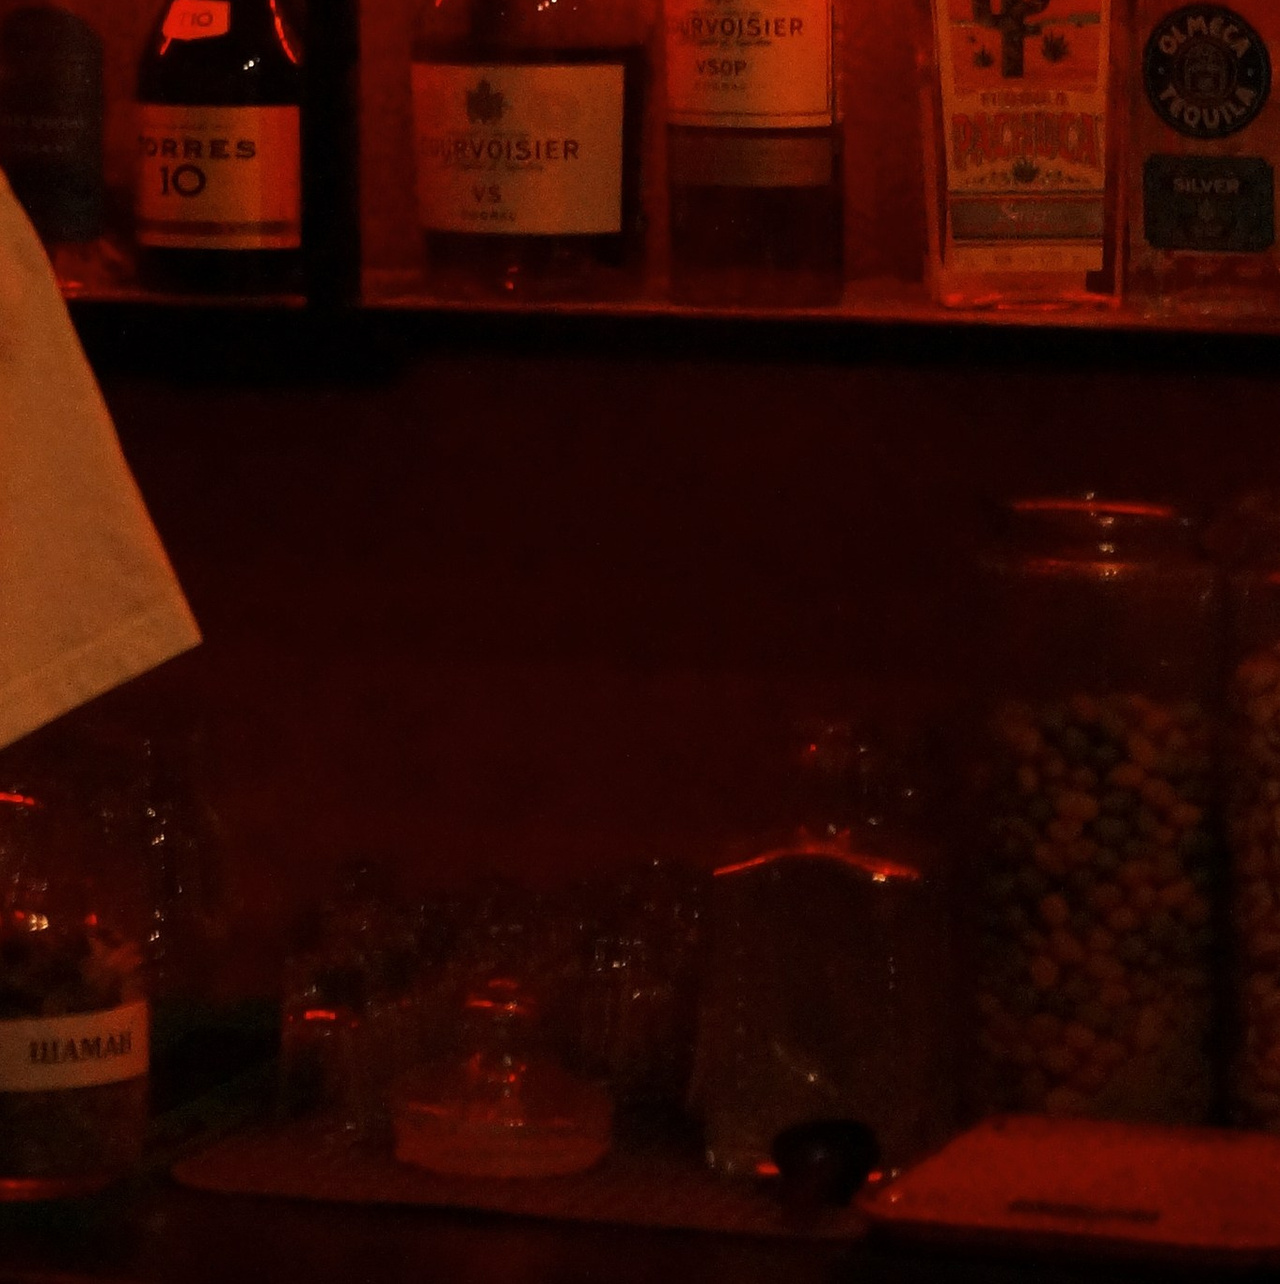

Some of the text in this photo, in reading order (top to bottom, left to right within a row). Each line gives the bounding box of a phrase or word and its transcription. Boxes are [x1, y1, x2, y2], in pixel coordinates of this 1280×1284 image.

[1158, 14, 1253, 59] OLMECA
[695, 59, 747, 76] VSOP
[1158, 82, 1258, 130] TEQUILA
[950, 110, 1099, 172] PACHUCA
[159, 163, 207, 198] 10
[471, 184, 502, 203] VS
[1172, 176, 1241, 194] SILVER
